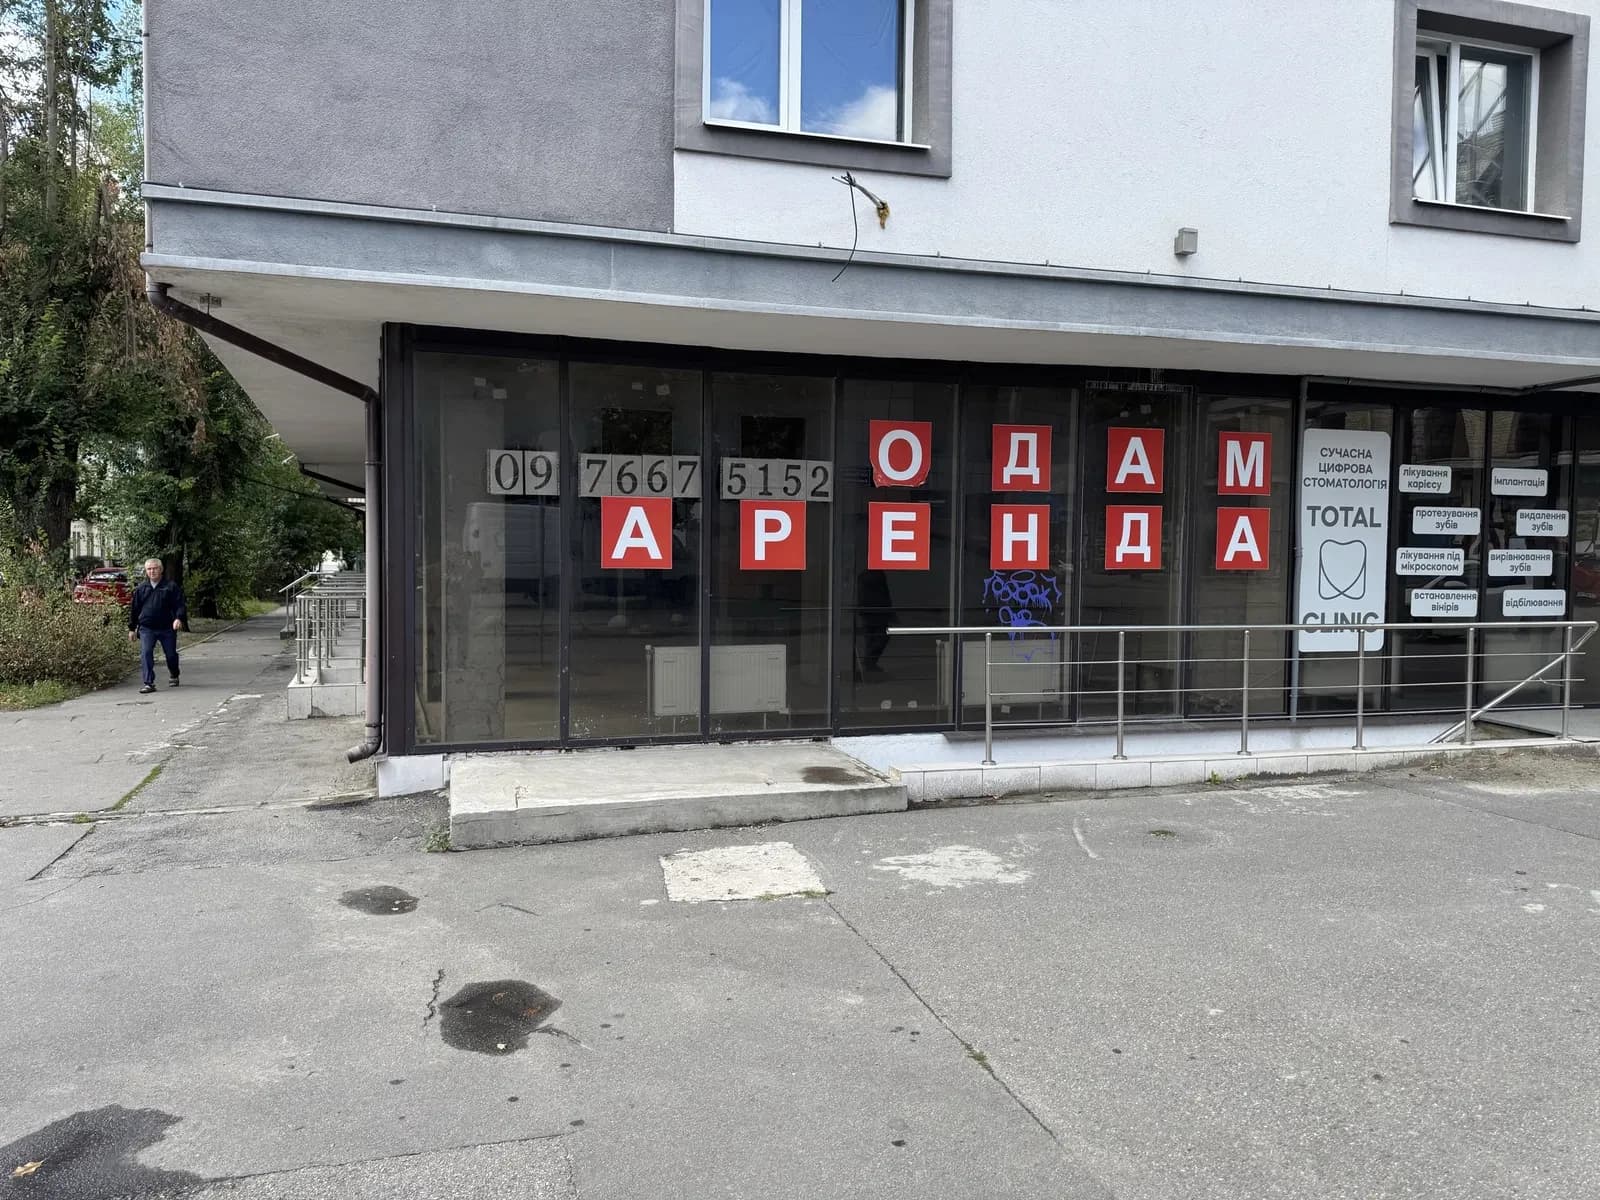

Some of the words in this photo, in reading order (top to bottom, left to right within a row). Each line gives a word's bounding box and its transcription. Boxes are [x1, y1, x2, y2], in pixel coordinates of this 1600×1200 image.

[1320, 447, 1373, 459] СУЧАСНА
[1318, 462, 1373, 474] ЦИФРОВА
[1403, 467, 1448, 478] лікування
[493, 452, 552, 491] 09
[585, 458, 699, 494] 7667
[726, 462, 830, 498] 5152
[1303, 477, 1387, 489] СТОМАТОЛОГІЯ
[1494, 476, 1545, 488] імплантація
[1306, 505, 1382, 527] TOTAL
[1415, 510, 1478, 519] протезування
[1519, 512, 1566, 521] видалення
[1435, 520, 1458, 531] зубів
[1531, 522, 1554, 533] зубів
[1400, 550, 1445, 561] лікування
[1446, 551, 1461, 562] під
[1490, 552, 1551, 563] вирівнювання
[1401, 562, 1459, 573] мікроскопом
[1509, 563, 1532, 573] зубів
[1414, 592, 1477, 601] встановлення
[1431, 602, 1460, 613] вінірів
[1505, 597, 1563, 608] відбілювання
[1302, 612, 1379, 633] CLINIC
